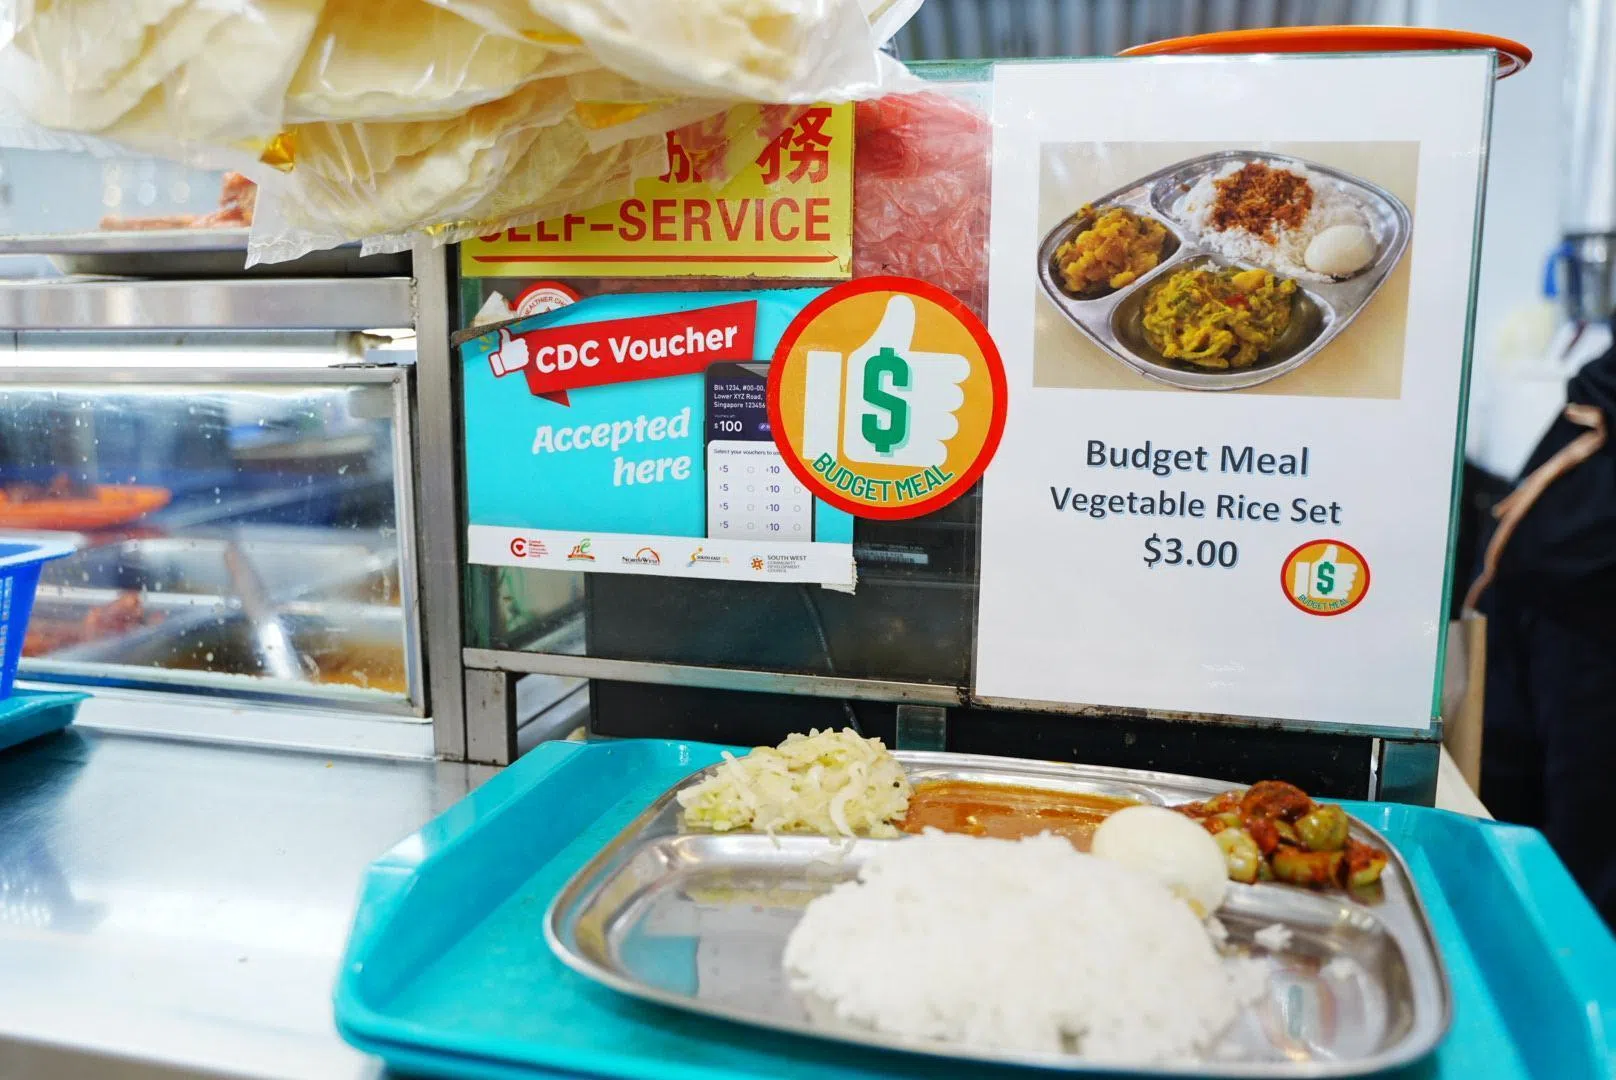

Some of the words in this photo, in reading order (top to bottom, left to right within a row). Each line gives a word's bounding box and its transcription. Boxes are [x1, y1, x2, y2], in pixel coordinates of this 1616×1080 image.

[479, 198, 831, 243] LF-SERVICE
[535, 340, 600, 374] CDC
[608, 325, 738, 364] Voucher
[713, 401, 744, 409] Singapore
[726, 384, 741, 392] 1234,
[745, 393, 763, 401] Road,
[531, 407, 691, 455] Accepted
[714, 420, 743, 432] $100
[612, 455, 691, 487] here
[1086, 439, 1208, 476] Budget
[1220, 444, 1309, 476] Meal
[812, 452, 892, 502] BUDGET
[895, 464, 954, 501] MEAL
[1050, 486, 1205, 518] Vegetable
[1216, 494, 1280, 521] Rice
[1290, 498, 1342, 524] Set
[1143, 532, 1239, 568] $3.00
[1298, 594, 1327, 611] BUDGET
